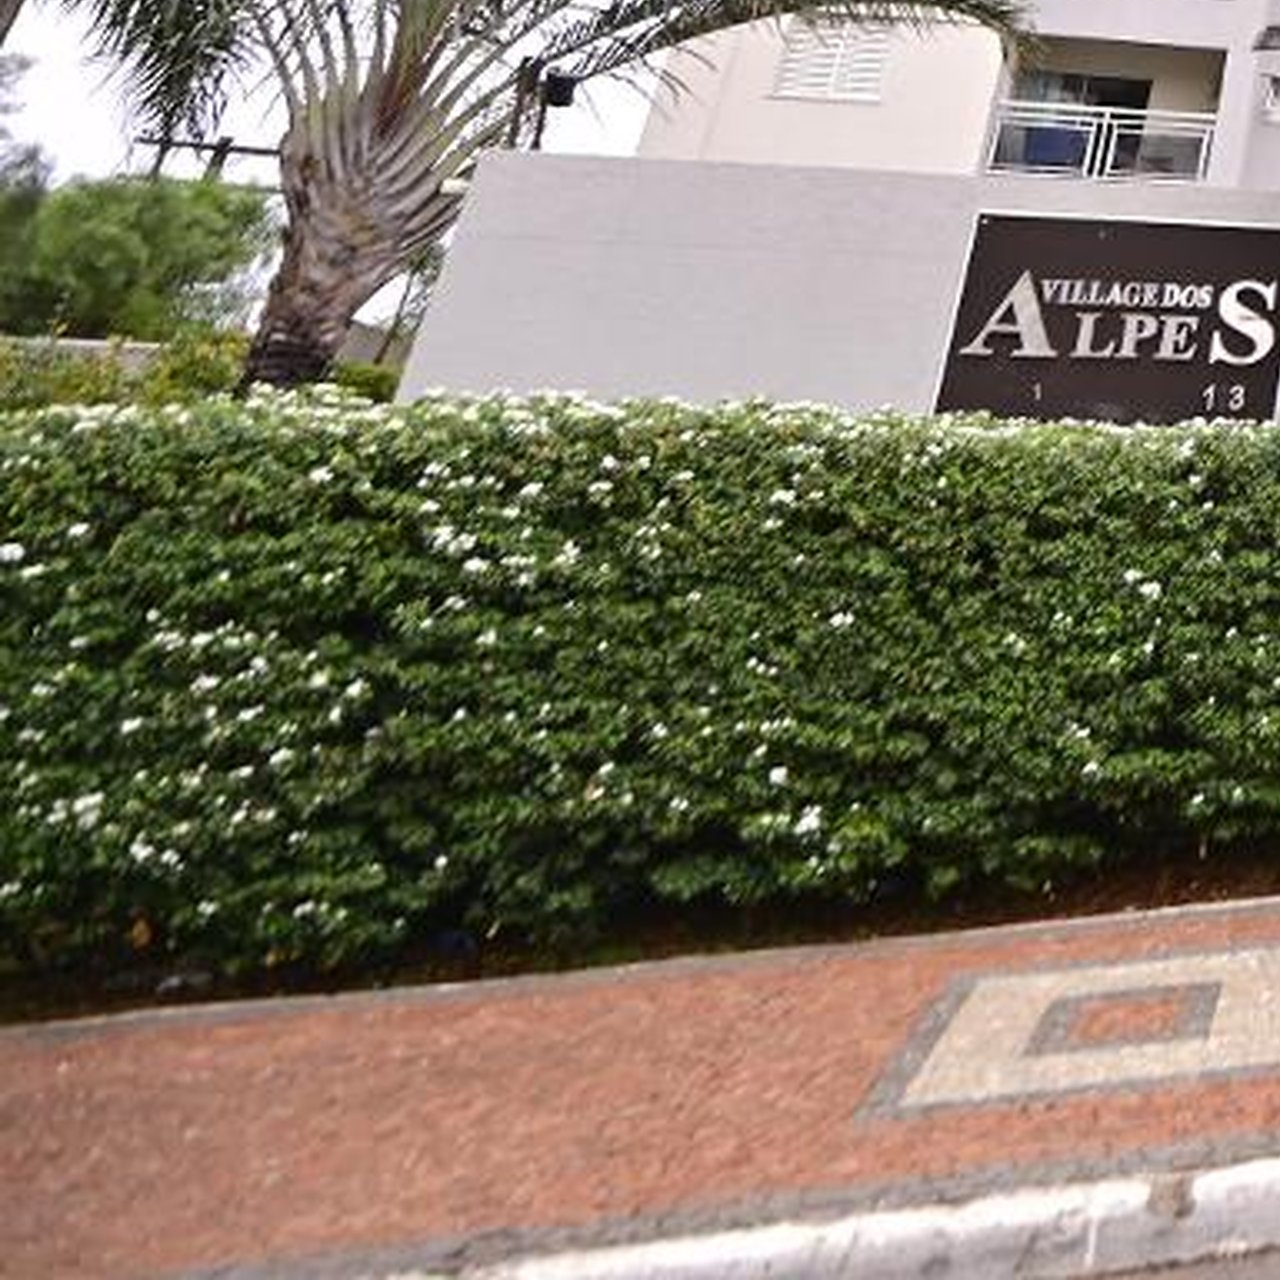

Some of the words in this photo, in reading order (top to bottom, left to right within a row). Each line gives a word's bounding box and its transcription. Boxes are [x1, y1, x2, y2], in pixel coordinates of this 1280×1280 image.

[959, 269, 1277, 365] ALPES
[1041, 279, 1158, 306] VILLAGE
[1162, 283, 1215, 308] DOS
